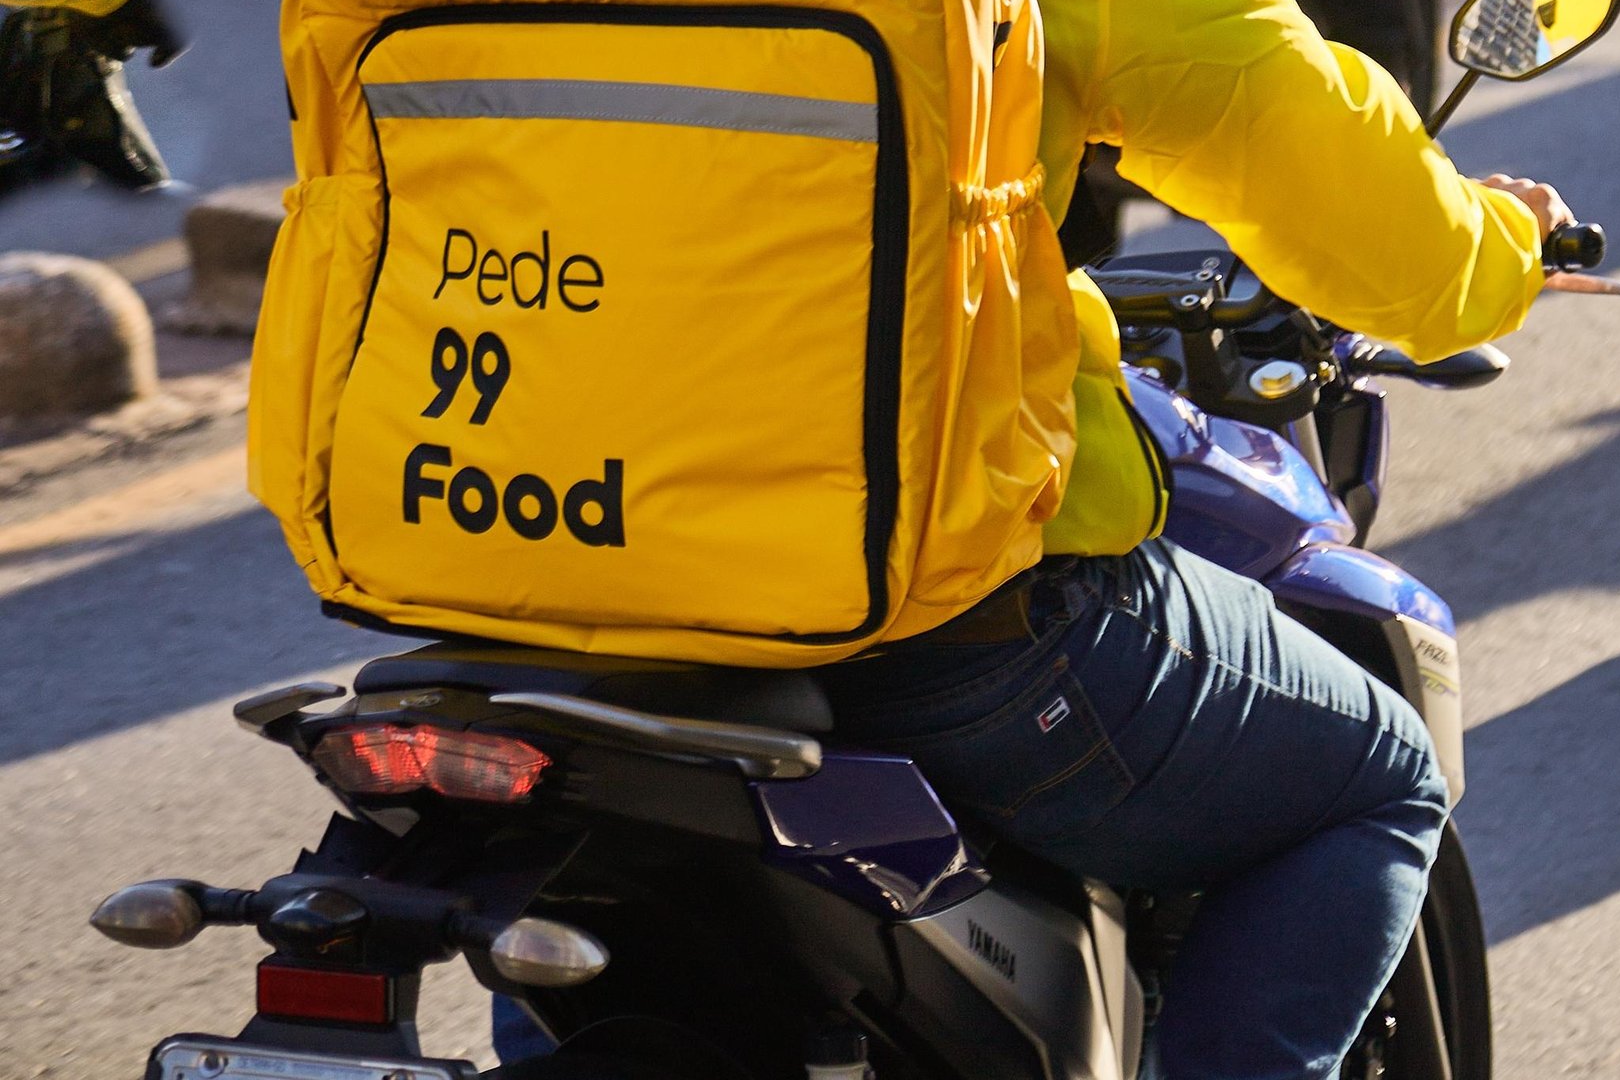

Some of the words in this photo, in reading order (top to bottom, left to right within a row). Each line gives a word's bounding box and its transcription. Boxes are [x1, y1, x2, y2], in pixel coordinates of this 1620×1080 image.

[432, 228, 605, 313] Pede
[420, 326, 511, 426] 99
[402, 442, 626, 549] Food
[967, 919, 1016, 983] YAMAHA
